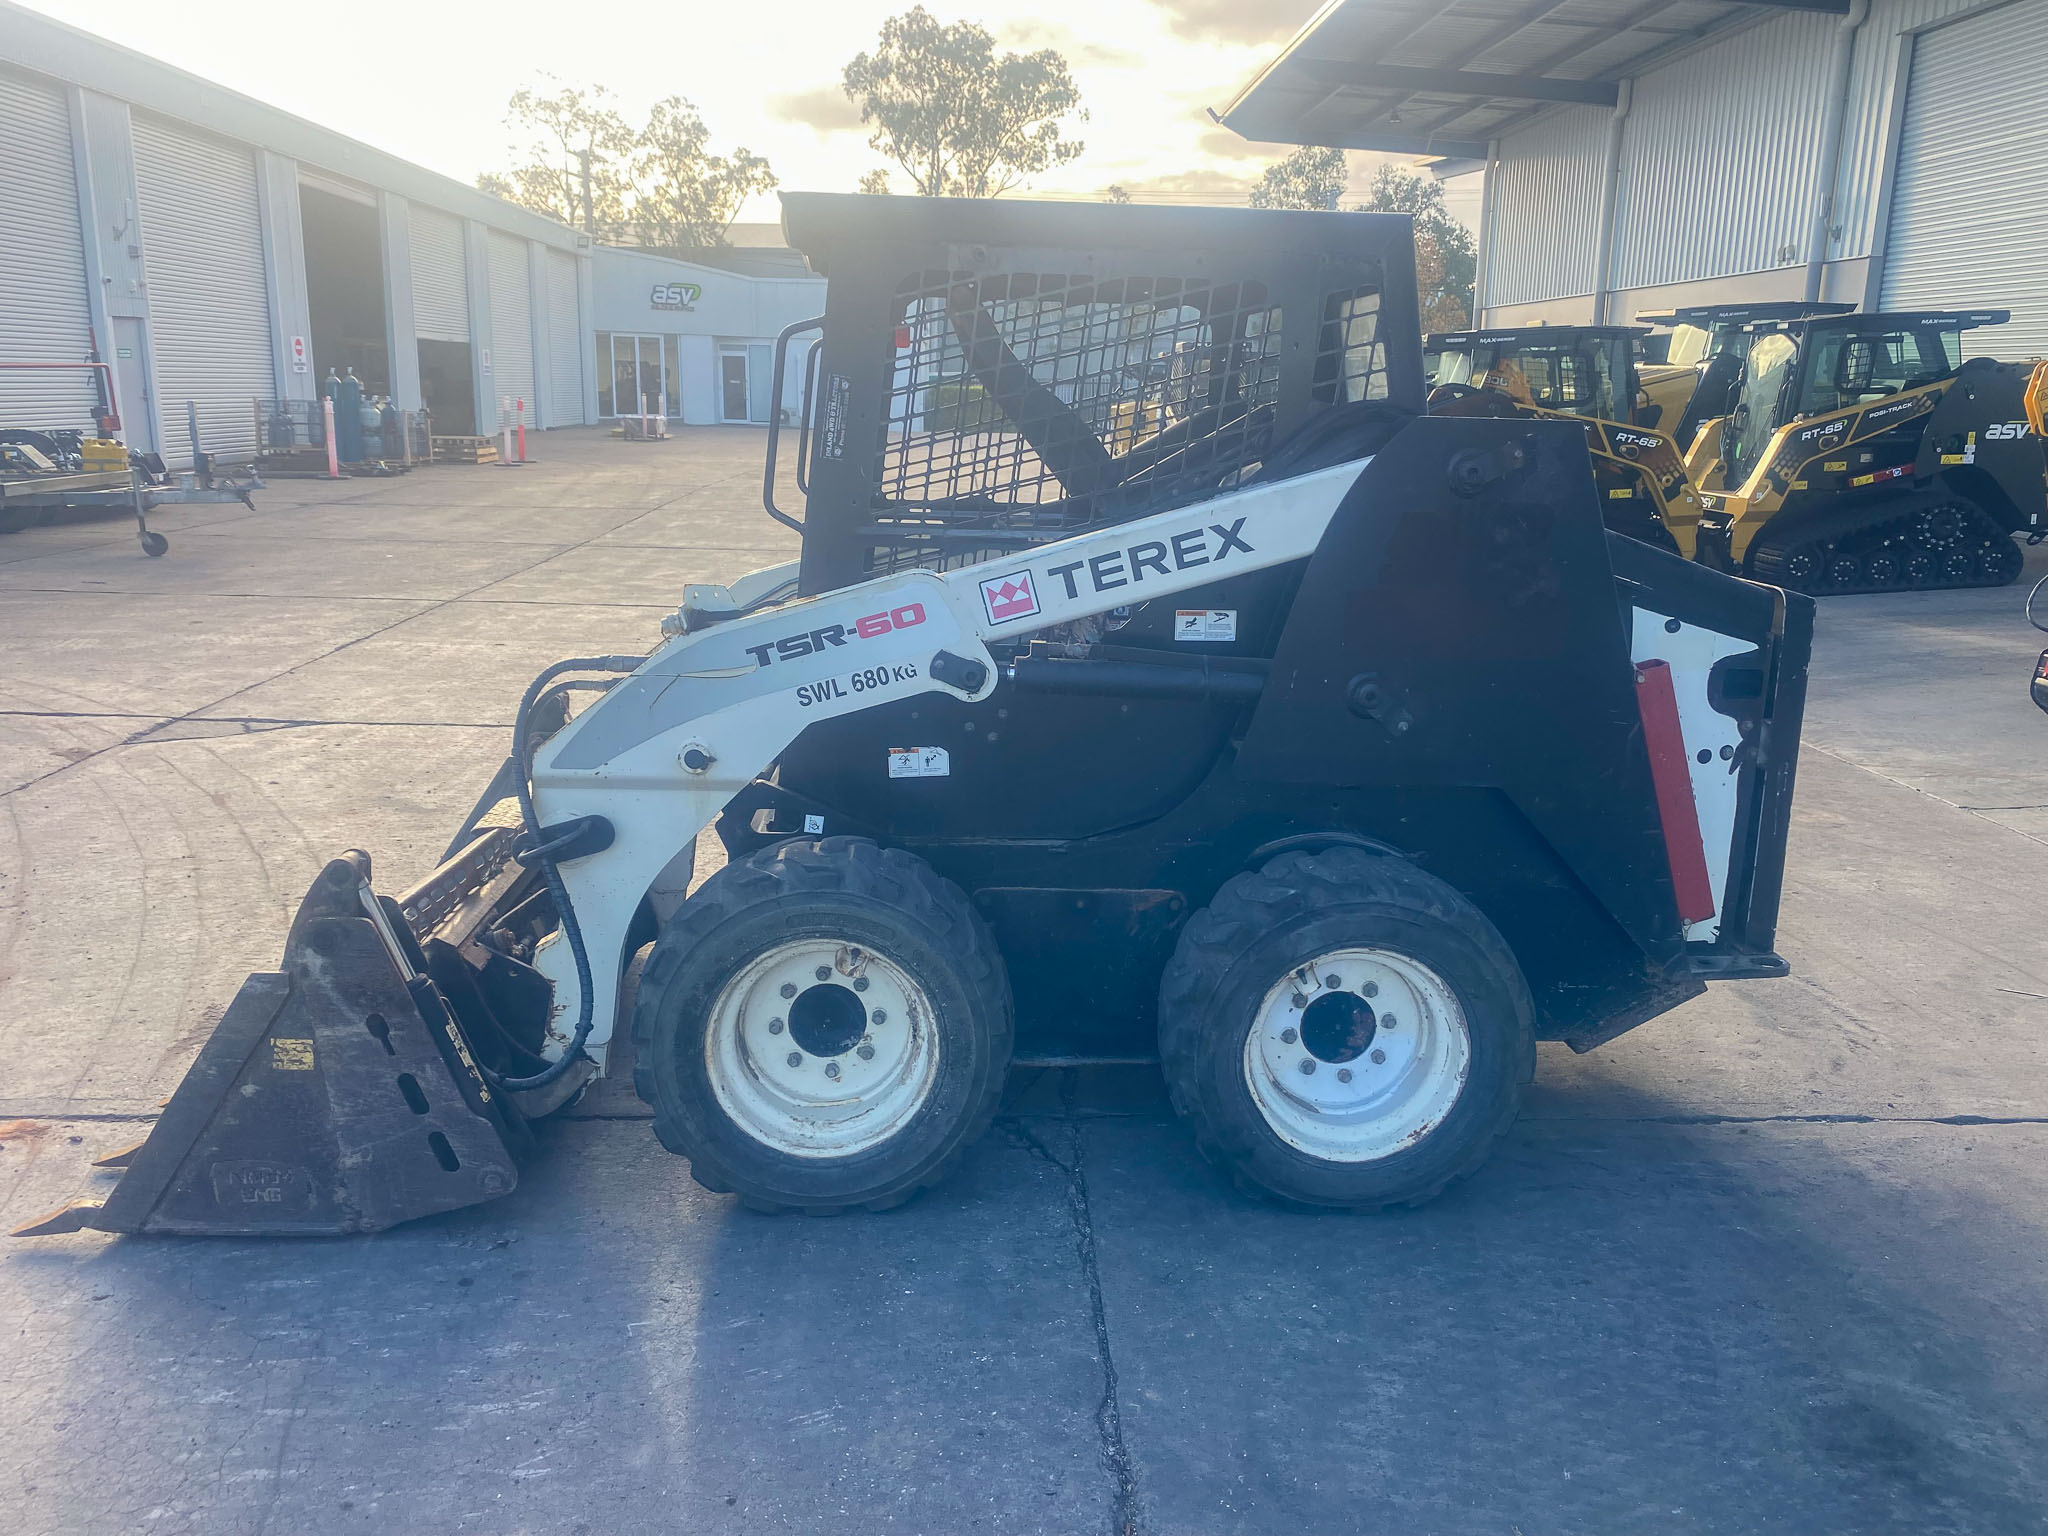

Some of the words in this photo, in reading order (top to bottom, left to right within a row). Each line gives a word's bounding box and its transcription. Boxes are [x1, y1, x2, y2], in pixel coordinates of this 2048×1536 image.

[1869, 402, 1913, 419] POSI-TRACK
[1616, 433, 1658, 448] RT-65
[1802, 421, 1844, 441] RT-65
[1047, 516, 1256, 600] TEREX
[745, 602, 927, 668] TSR-60
[796, 678, 848, 707] SWL
[851, 666, 890, 692] 680
[892, 663, 918, 682] KG
